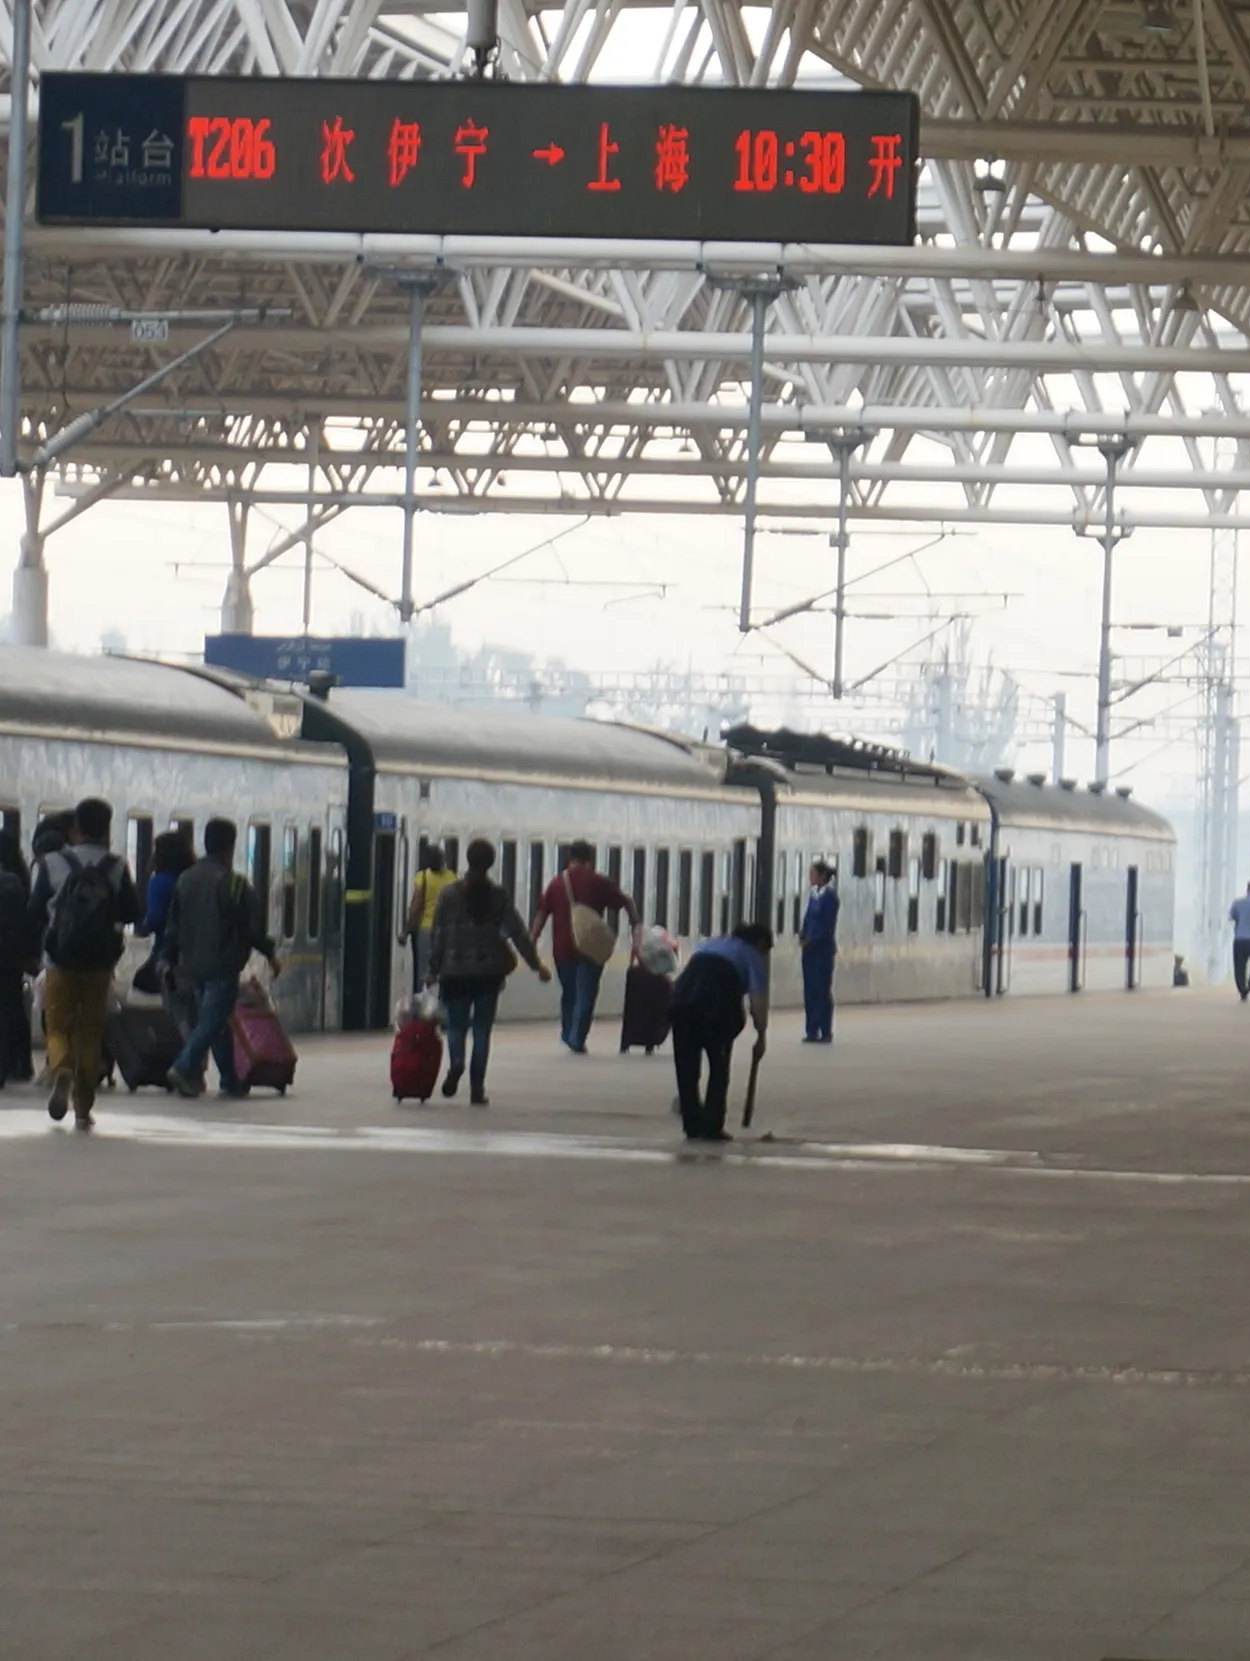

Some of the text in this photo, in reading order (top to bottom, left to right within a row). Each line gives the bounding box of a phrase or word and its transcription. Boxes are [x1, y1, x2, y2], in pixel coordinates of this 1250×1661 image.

[61, 111, 84, 183] 1
[95, 128, 175, 168] 站台
[188, 116, 276, 180] T206
[733, 129, 846, 194] 10:30
[867, 134, 903, 199] 开
